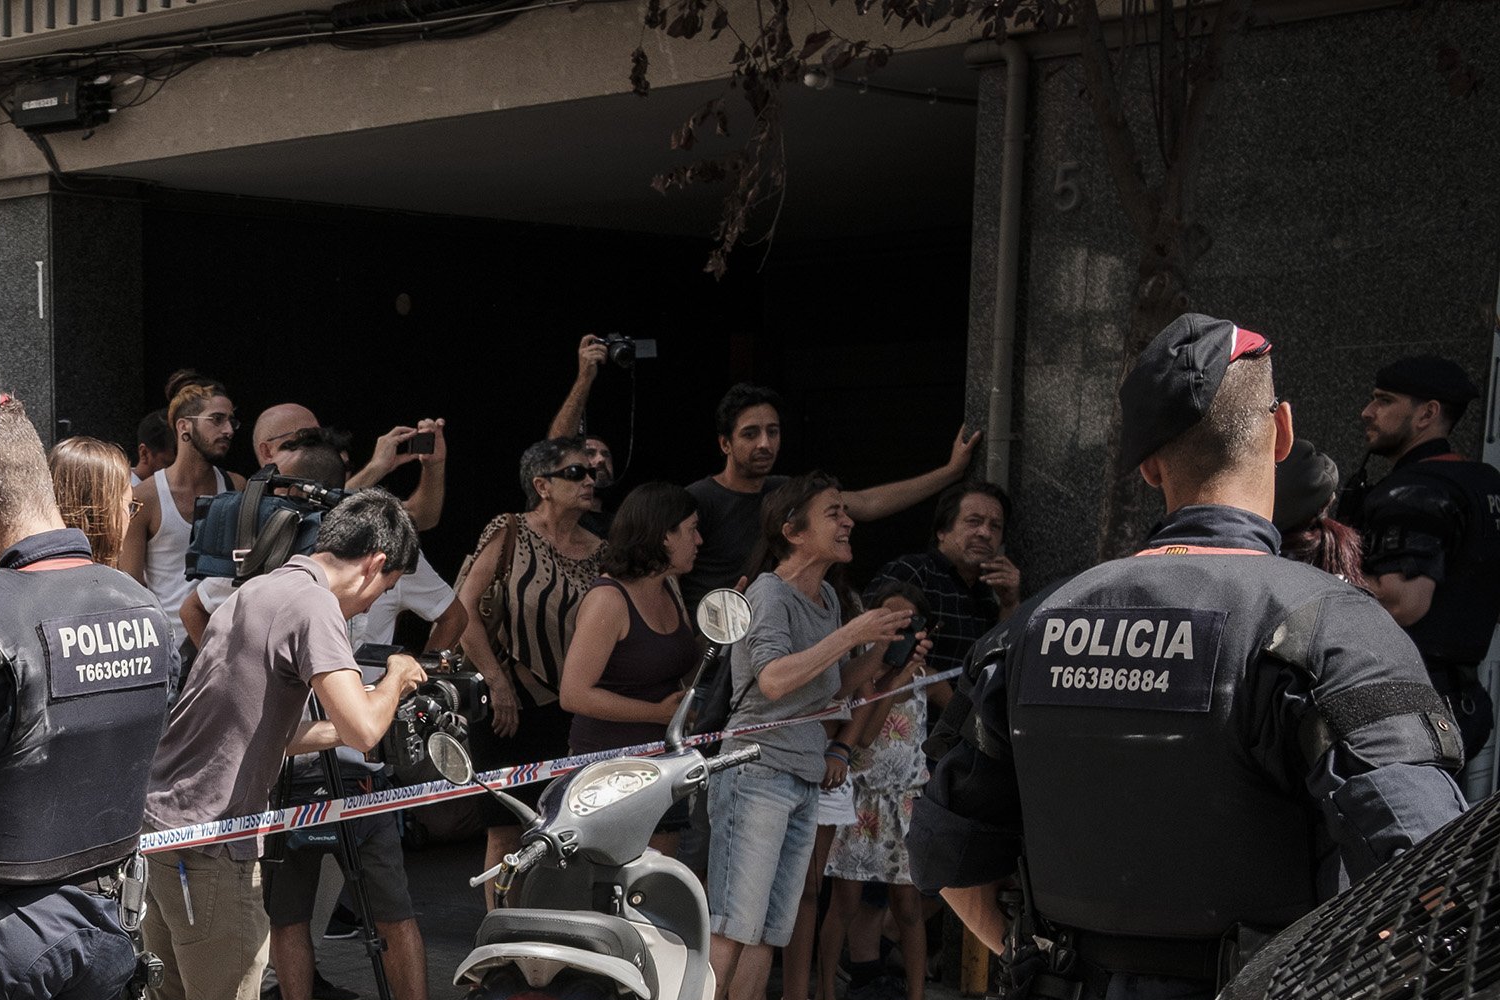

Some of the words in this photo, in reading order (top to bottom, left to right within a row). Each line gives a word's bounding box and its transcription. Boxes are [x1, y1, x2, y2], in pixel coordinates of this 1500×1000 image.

[1054, 161, 1081, 211] 5
[58, 617, 160, 658] POLICIA
[1040, 617, 1194, 660] POLICIA
[76, 656, 152, 682] T663C8172
[1050, 665, 1170, 693] T663B6884
